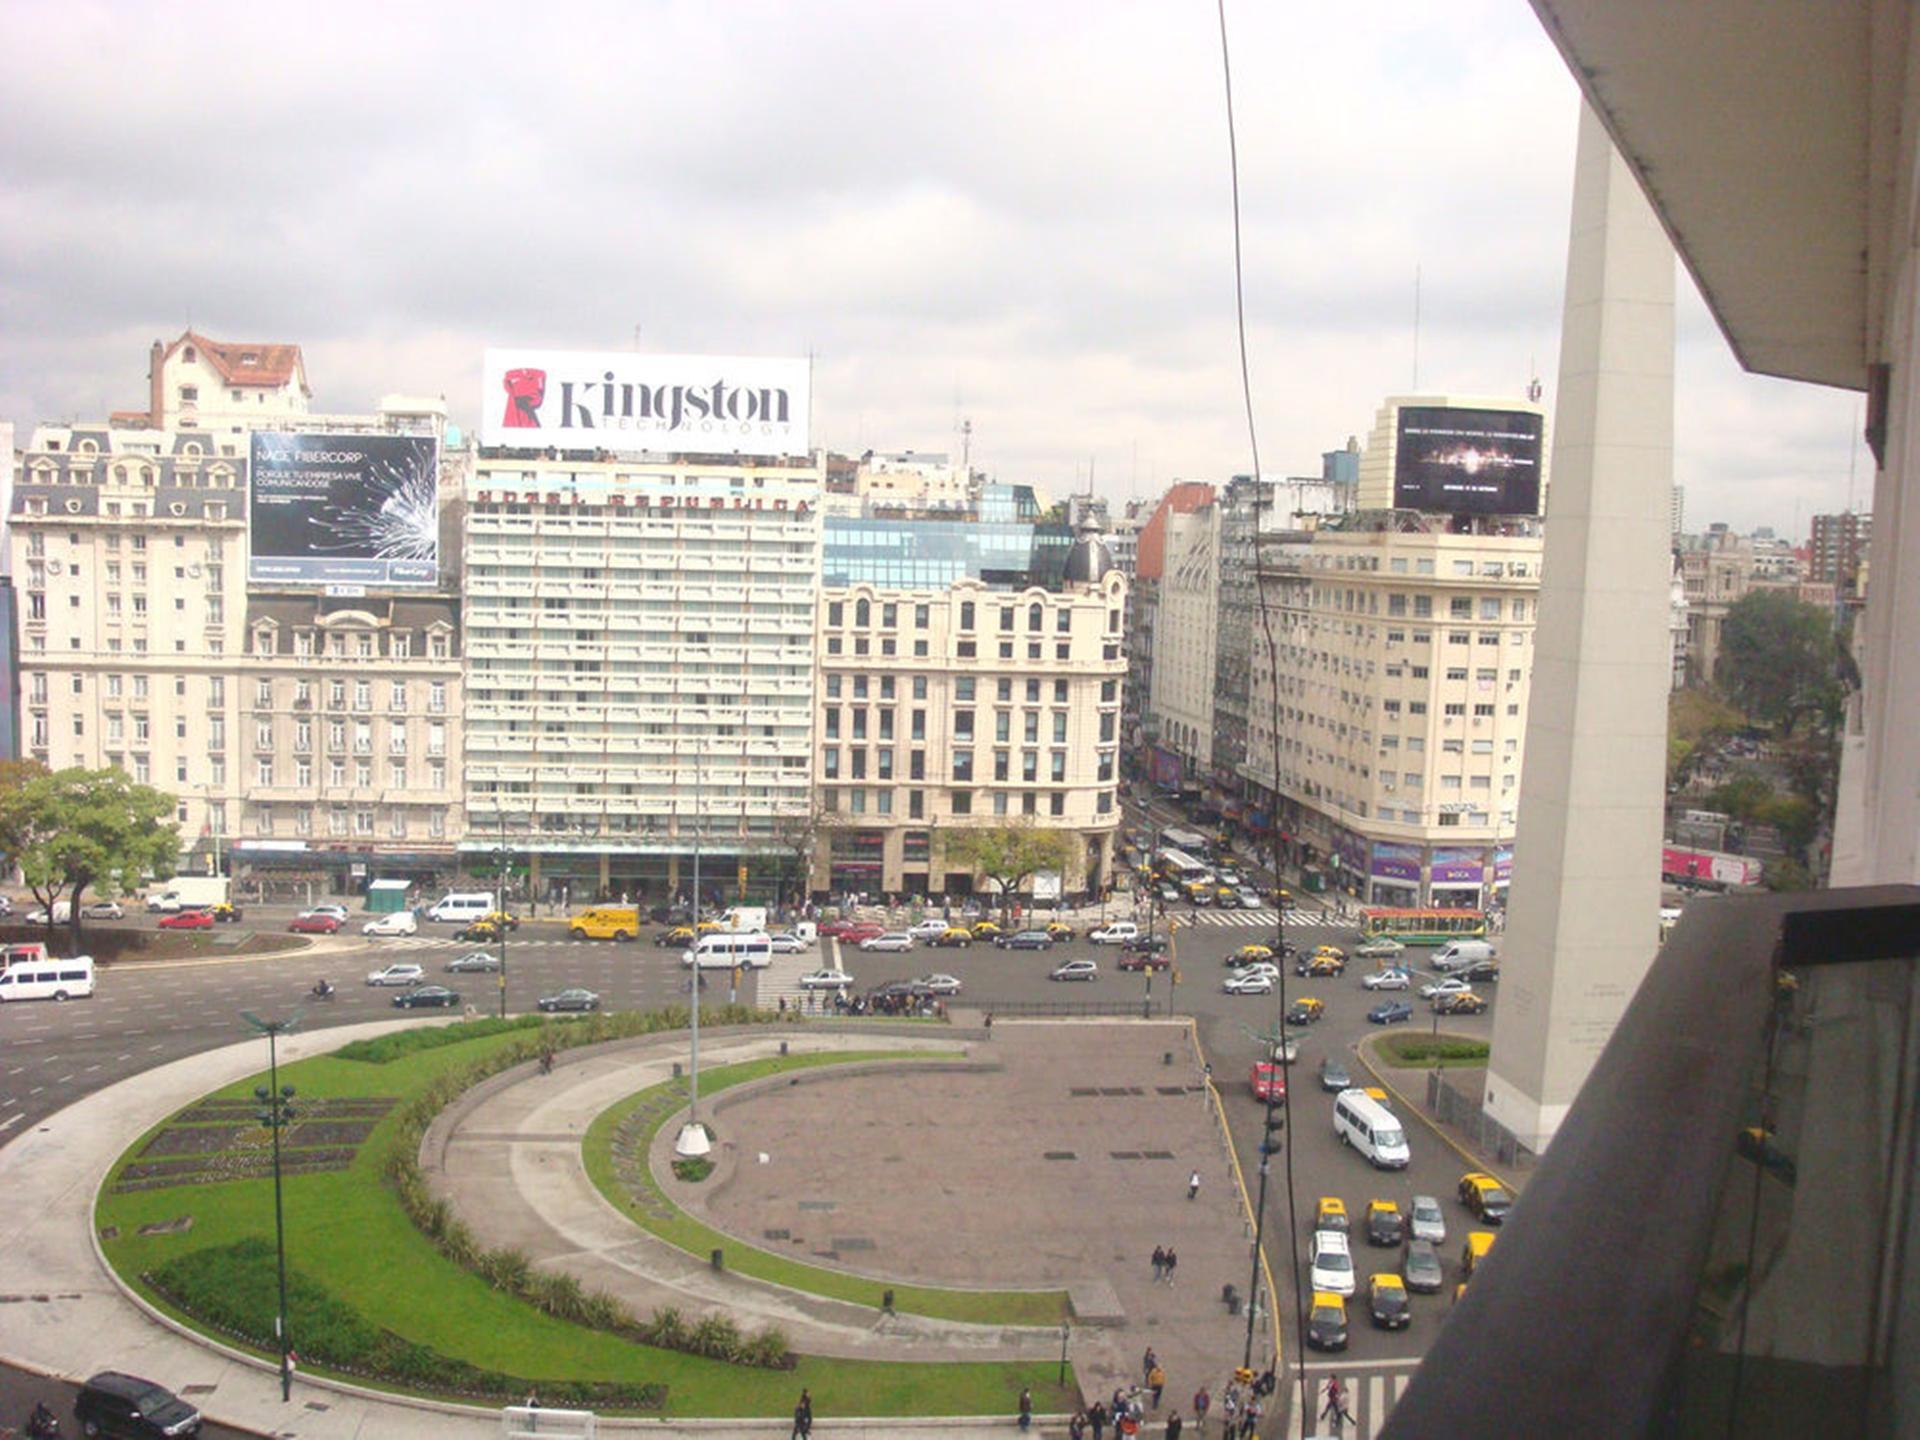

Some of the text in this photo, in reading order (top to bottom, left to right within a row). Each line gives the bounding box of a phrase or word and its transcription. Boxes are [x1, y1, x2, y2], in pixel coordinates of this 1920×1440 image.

[560, 371, 790, 431] Kingston
[602, 418, 790, 434] TECHNOLOGY
[295, 451, 362, 462] FIBERCORP
[478, 490, 585, 505] HOTEL
